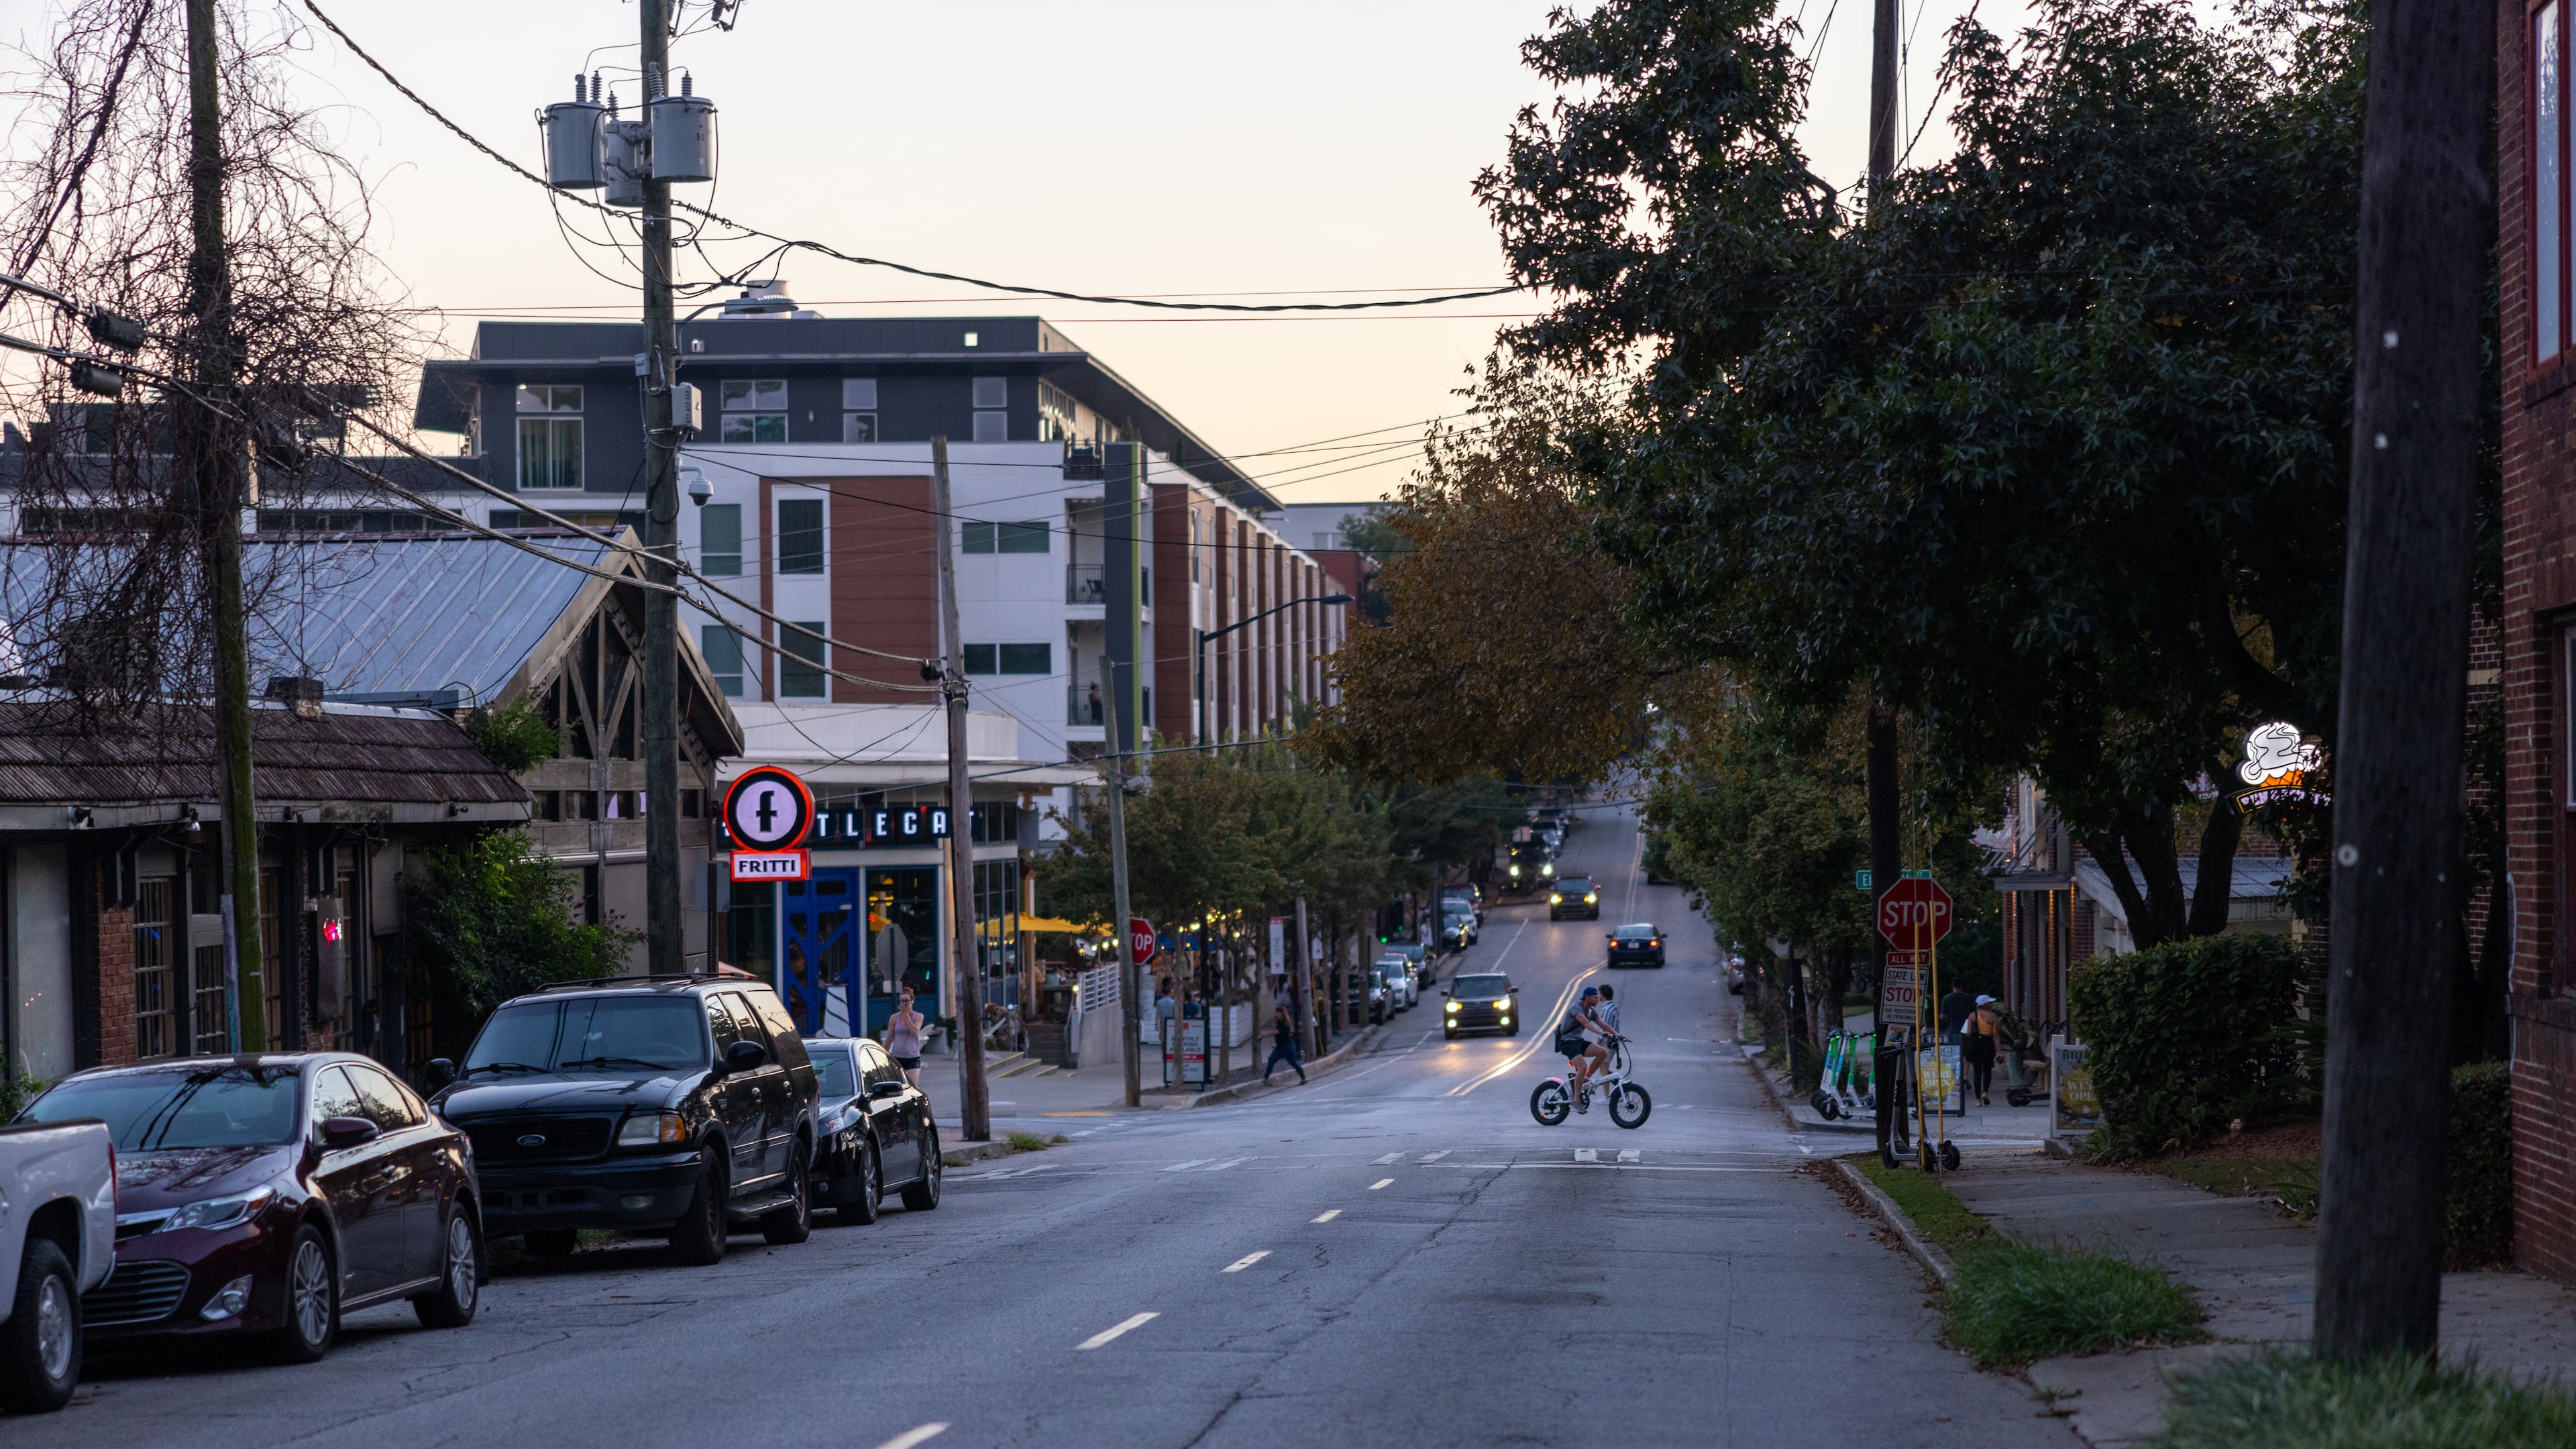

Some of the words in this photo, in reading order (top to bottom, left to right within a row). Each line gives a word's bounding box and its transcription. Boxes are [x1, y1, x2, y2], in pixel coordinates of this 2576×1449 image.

[739, 860, 796, 873] FRITTI
[1884, 901, 1947, 927] STOP
[1890, 955, 1906, 964] ALL
[1910, 954, 1927, 963] WY
[1887, 970, 1907, 980] STATE
[1911, 972, 1925, 981] LW
[1886, 987, 1923, 1002] STOP
[2070, 1091, 2094, 1101] OPE
